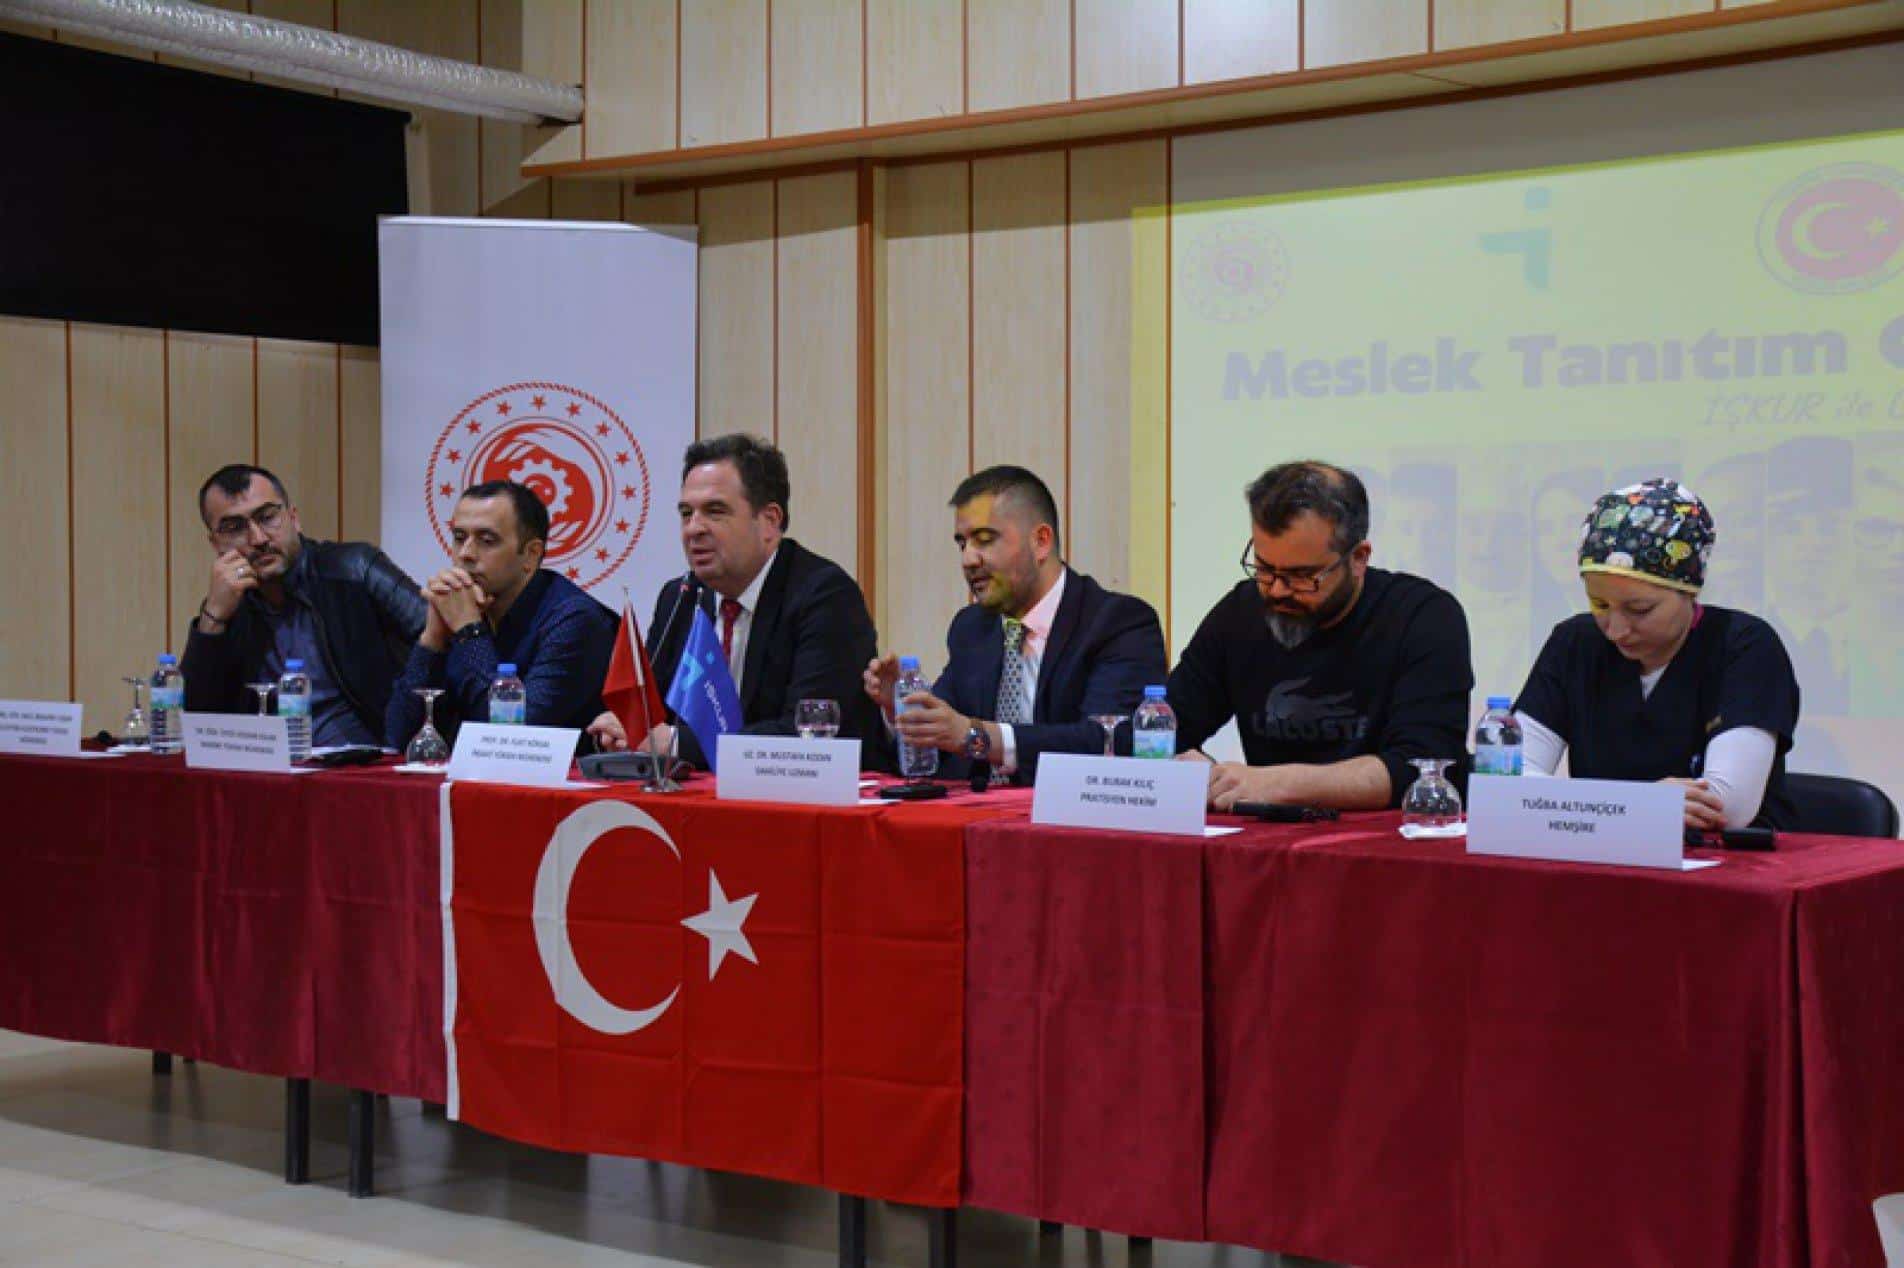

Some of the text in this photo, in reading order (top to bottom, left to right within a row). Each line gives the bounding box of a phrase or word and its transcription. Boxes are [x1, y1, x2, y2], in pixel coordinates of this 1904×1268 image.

[1222, 339, 1484, 401] Meslek
[1507, 328, 1847, 388] Tanıtım
[1250, 713, 1369, 739] LACOSTE
[1521, 796, 1558, 810] TUĞBA
